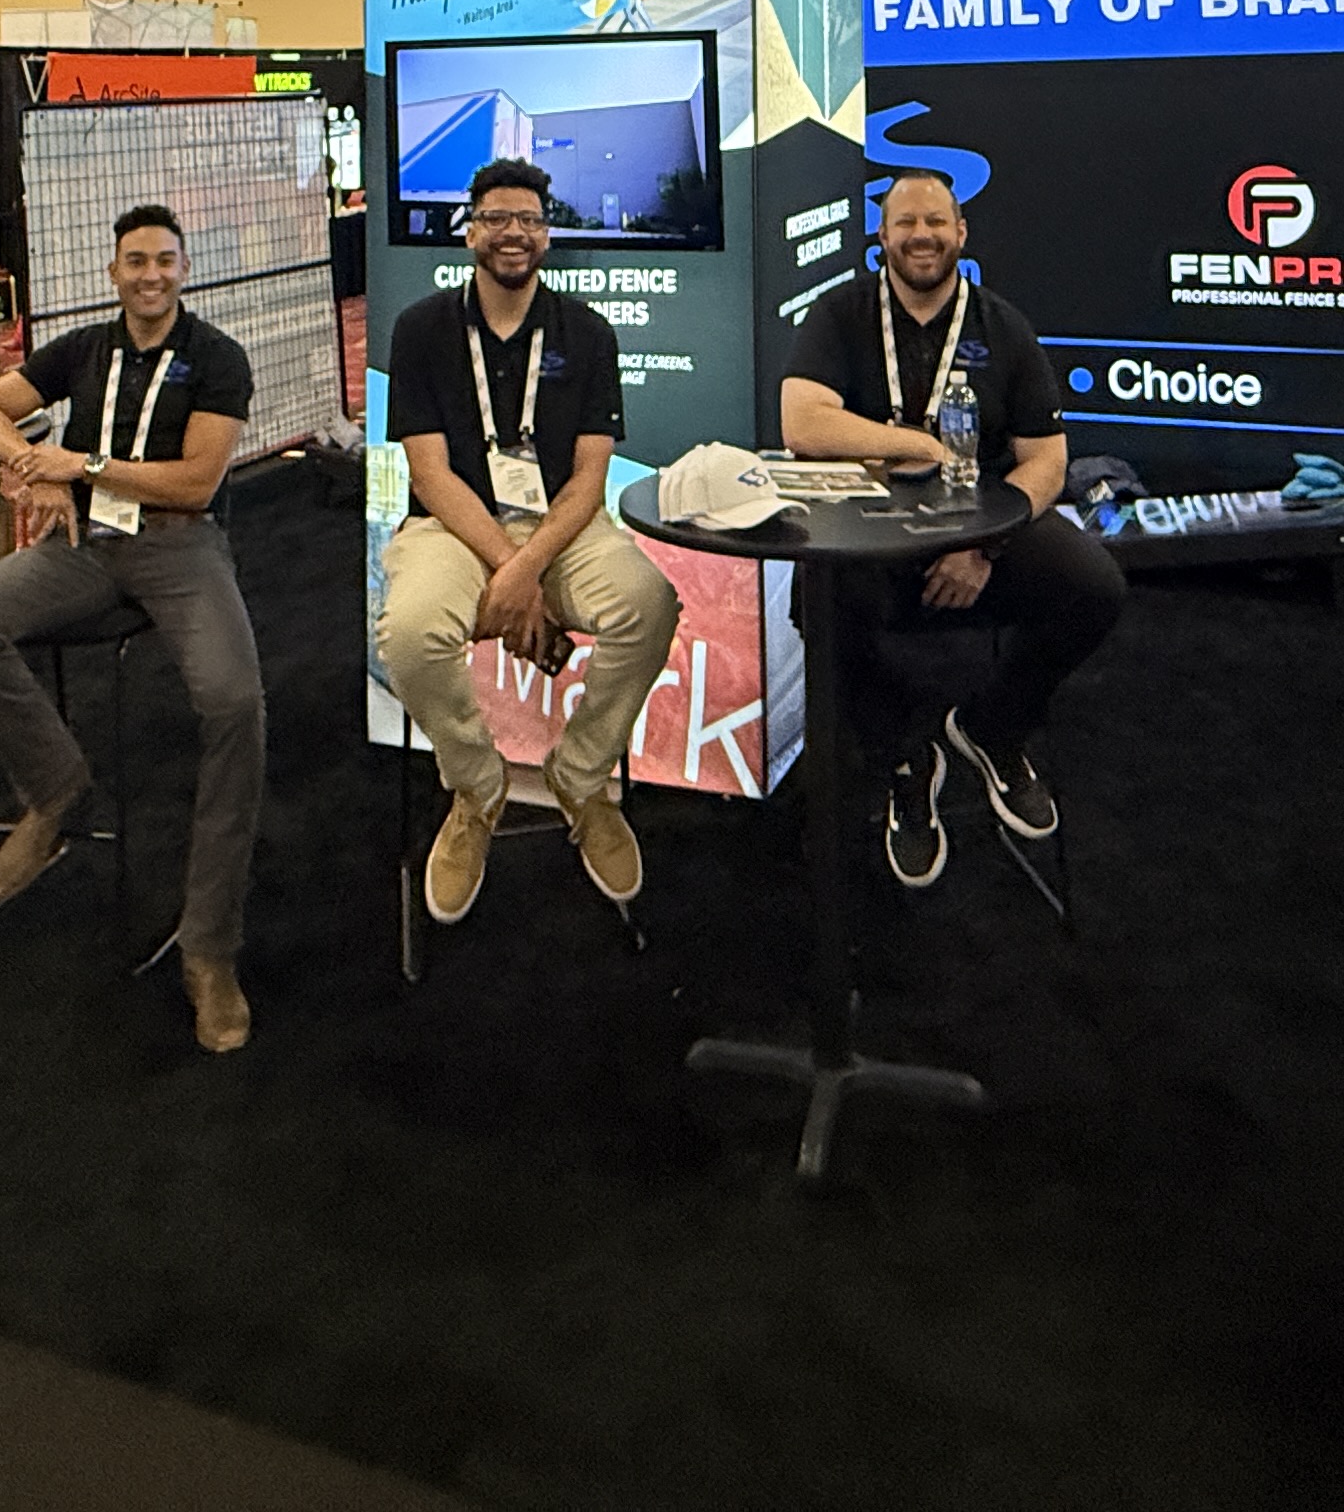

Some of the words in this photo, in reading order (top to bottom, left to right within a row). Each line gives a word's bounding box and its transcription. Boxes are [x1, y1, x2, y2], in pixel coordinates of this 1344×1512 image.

[463, 3, 495, 25] Waiting
[496, 0, 514, 15] Area
[434, 265, 475, 289] CUS
[538, 269, 606, 293] INTED
[608, 269, 677, 294] FENCE
[1171, 288, 1283, 307] PROFESSIONAL
[1285, 291, 1335, 308] FENCE
[1108, 359, 1262, 407] Choice
